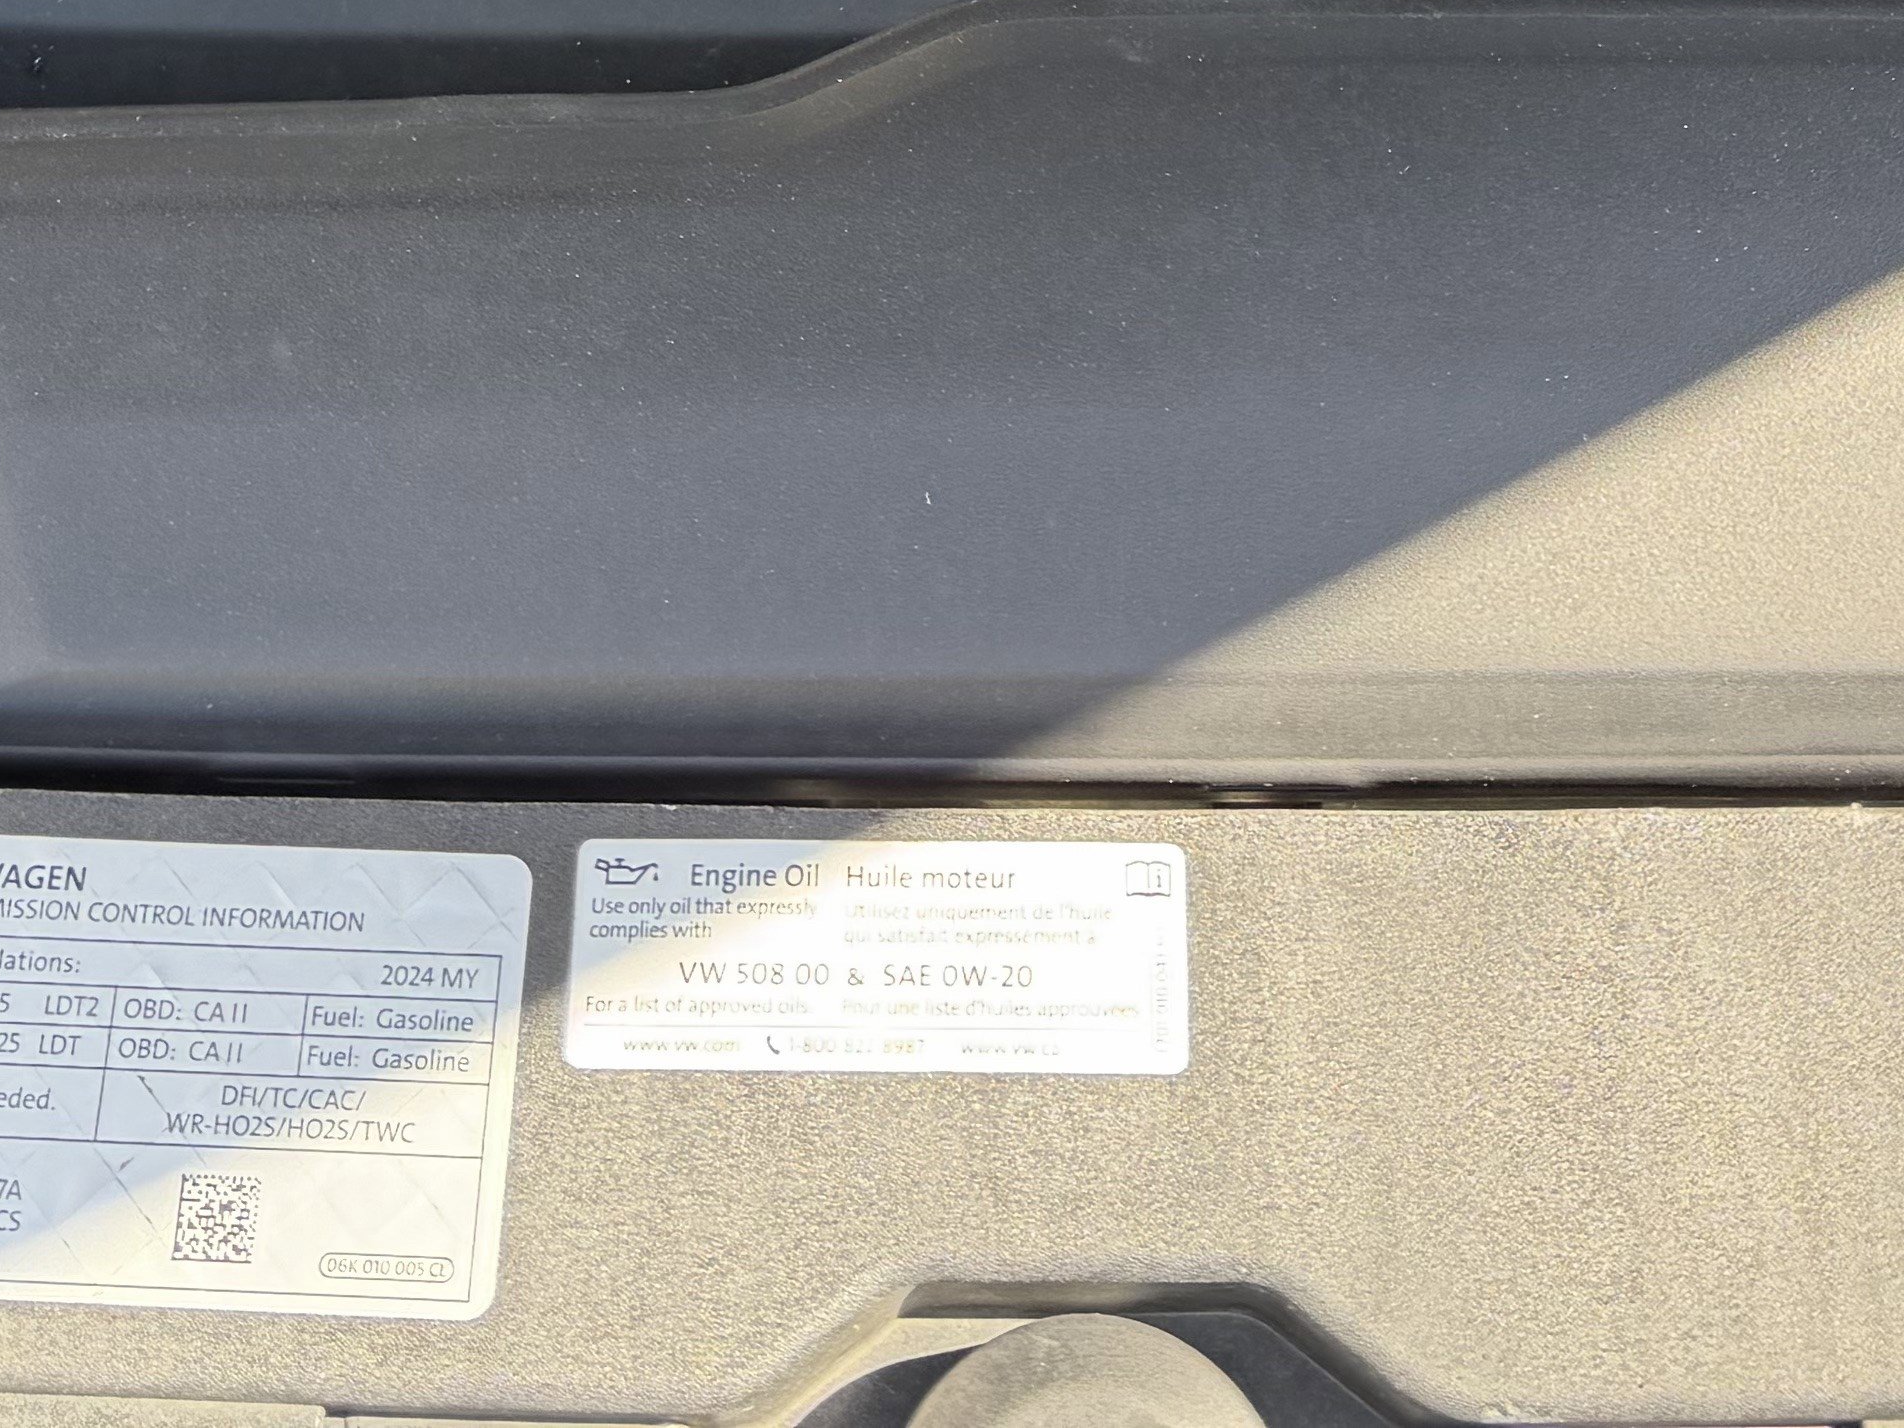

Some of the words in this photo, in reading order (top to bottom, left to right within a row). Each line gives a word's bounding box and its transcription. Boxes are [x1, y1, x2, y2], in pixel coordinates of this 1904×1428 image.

[690, 863, 778, 894] Engine
[784, 863, 820, 887] Oil
[846, 865, 913, 889] Huile
[921, 869, 1016, 890] moteur
[87, 901, 197, 928] CONTROL
[201, 906, 366, 933] INFORMATION
[591, 898, 625, 915] Use
[628, 897, 666, 920] only
[669, 897, 692, 915] oil
[695, 898, 732, 915] that
[736, 899, 818, 920] expressly
[916, 904, 1027, 925] uniquement
[1032, 904, 1053, 920] de
[589, 921, 668, 943] complies
[672, 921, 713, 939] with
[380, 964, 435, 988] 2024
[440, 967, 481, 990] MY
[678, 961, 727, 984] VW
[736, 962, 785, 986] 508
[795, 962, 830, 986] 00
[847, 967, 865, 987] &
[883, 964, 932, 987] SAE
[942, 964, 1034, 988] 0W-20
[43, 994, 100, 1018] LDT2
[122, 998, 183, 1022] OBD:
[585, 996, 614, 1013] For
[617, 999, 628, 1013] a
[633, 995, 659, 1014] list
[664, 996, 684, 1013] of
[687, 996, 773, 1017] approved
[886, 1002, 919, 1016] une
[924, 999, 960, 1016] liste
[310, 1005, 364, 1029] Fuel:
[375, 1007, 475, 1033] Gasoline
[37, 1032, 83, 1056] LDT
[117, 1037, 177, 1061] OBD:
[306, 1044, 359, 1069] Fuel:
[371, 1046, 471, 1074] Gasoline
[220, 1084, 368, 1112] DFI/TC/CAC/
[164, 1111, 417, 1144] WR-HO2S/HO2S/TWC
[327, 1257, 358, 1274] 06K
[362, 1258, 391, 1276] 010
[395, 1260, 426, 1277] 005
